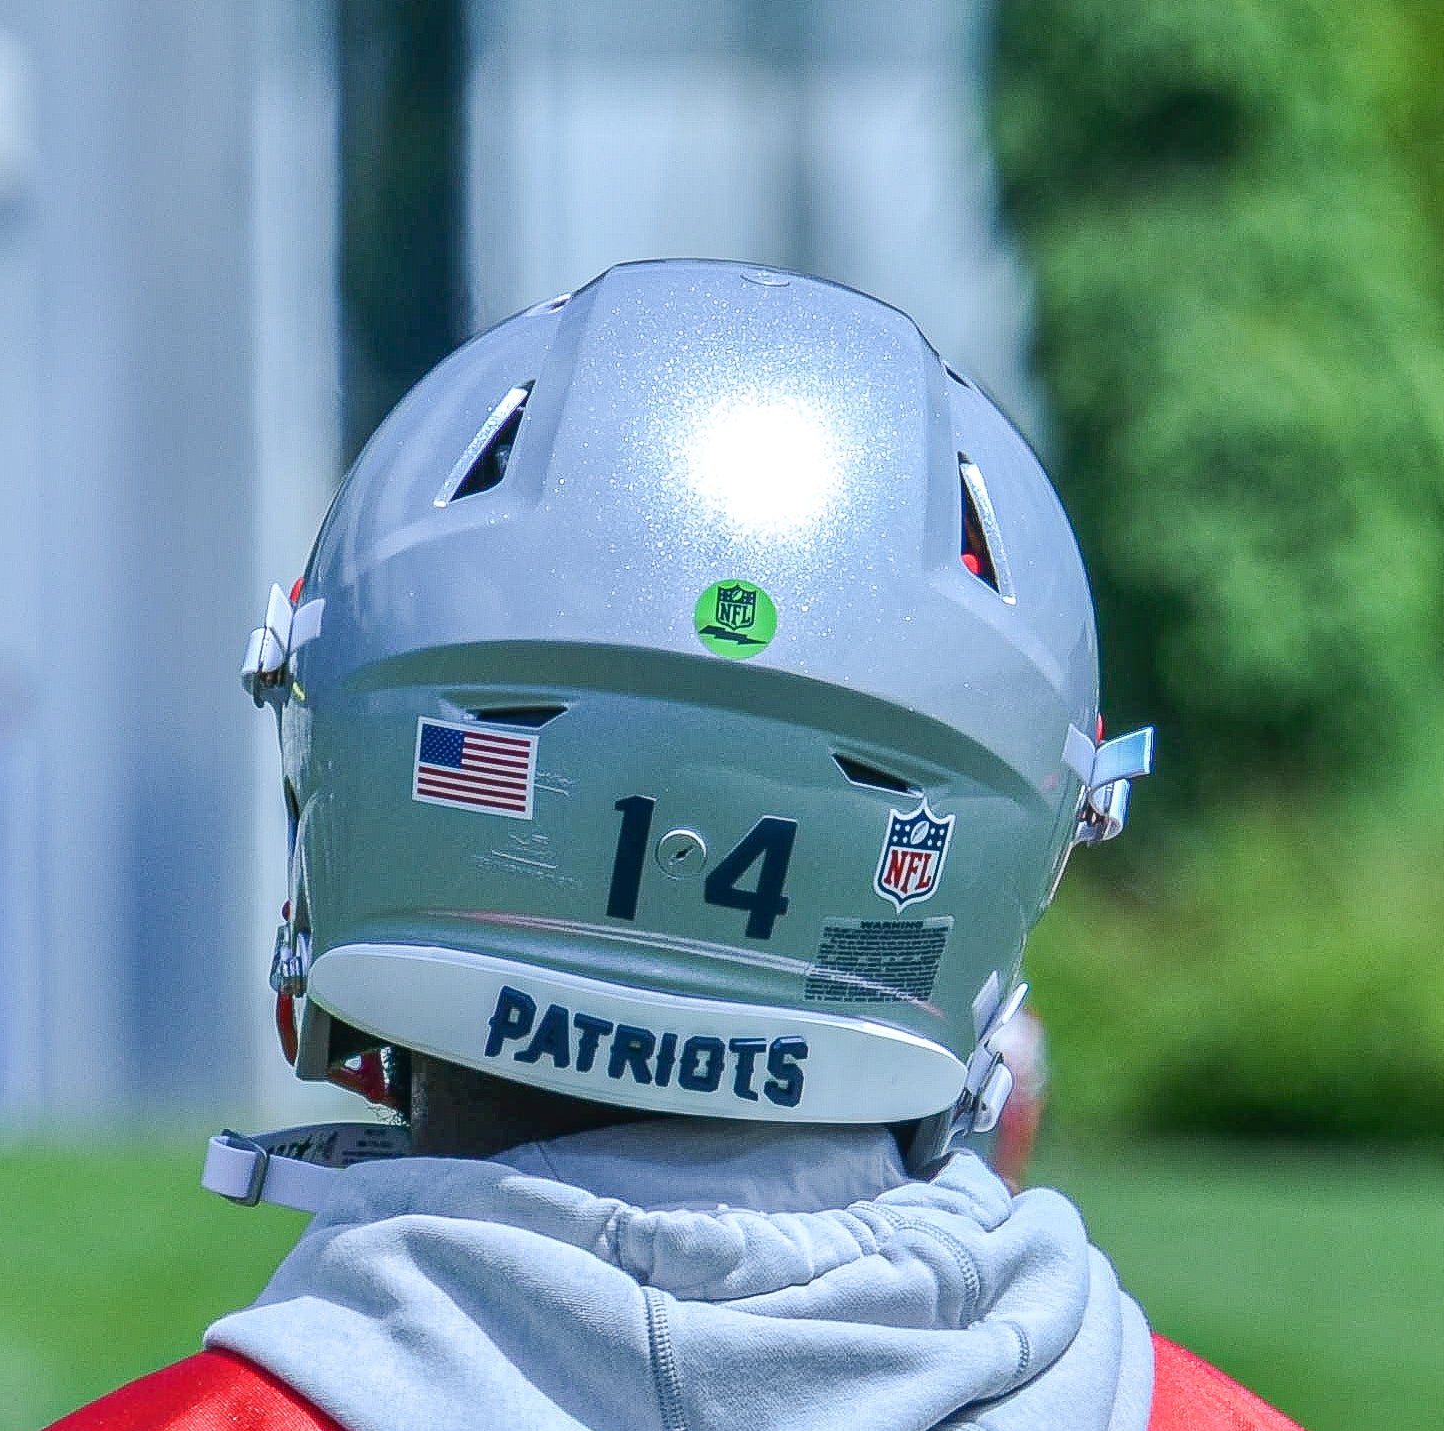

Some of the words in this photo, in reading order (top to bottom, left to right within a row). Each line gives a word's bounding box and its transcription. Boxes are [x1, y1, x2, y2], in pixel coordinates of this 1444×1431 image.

[720, 602, 751, 626] NFL
[606, 795, 798, 940] 14
[883, 849, 933, 894] NFL
[860, 920, 923, 930] WARNING
[484, 985, 809, 1107] PATRIOTS
